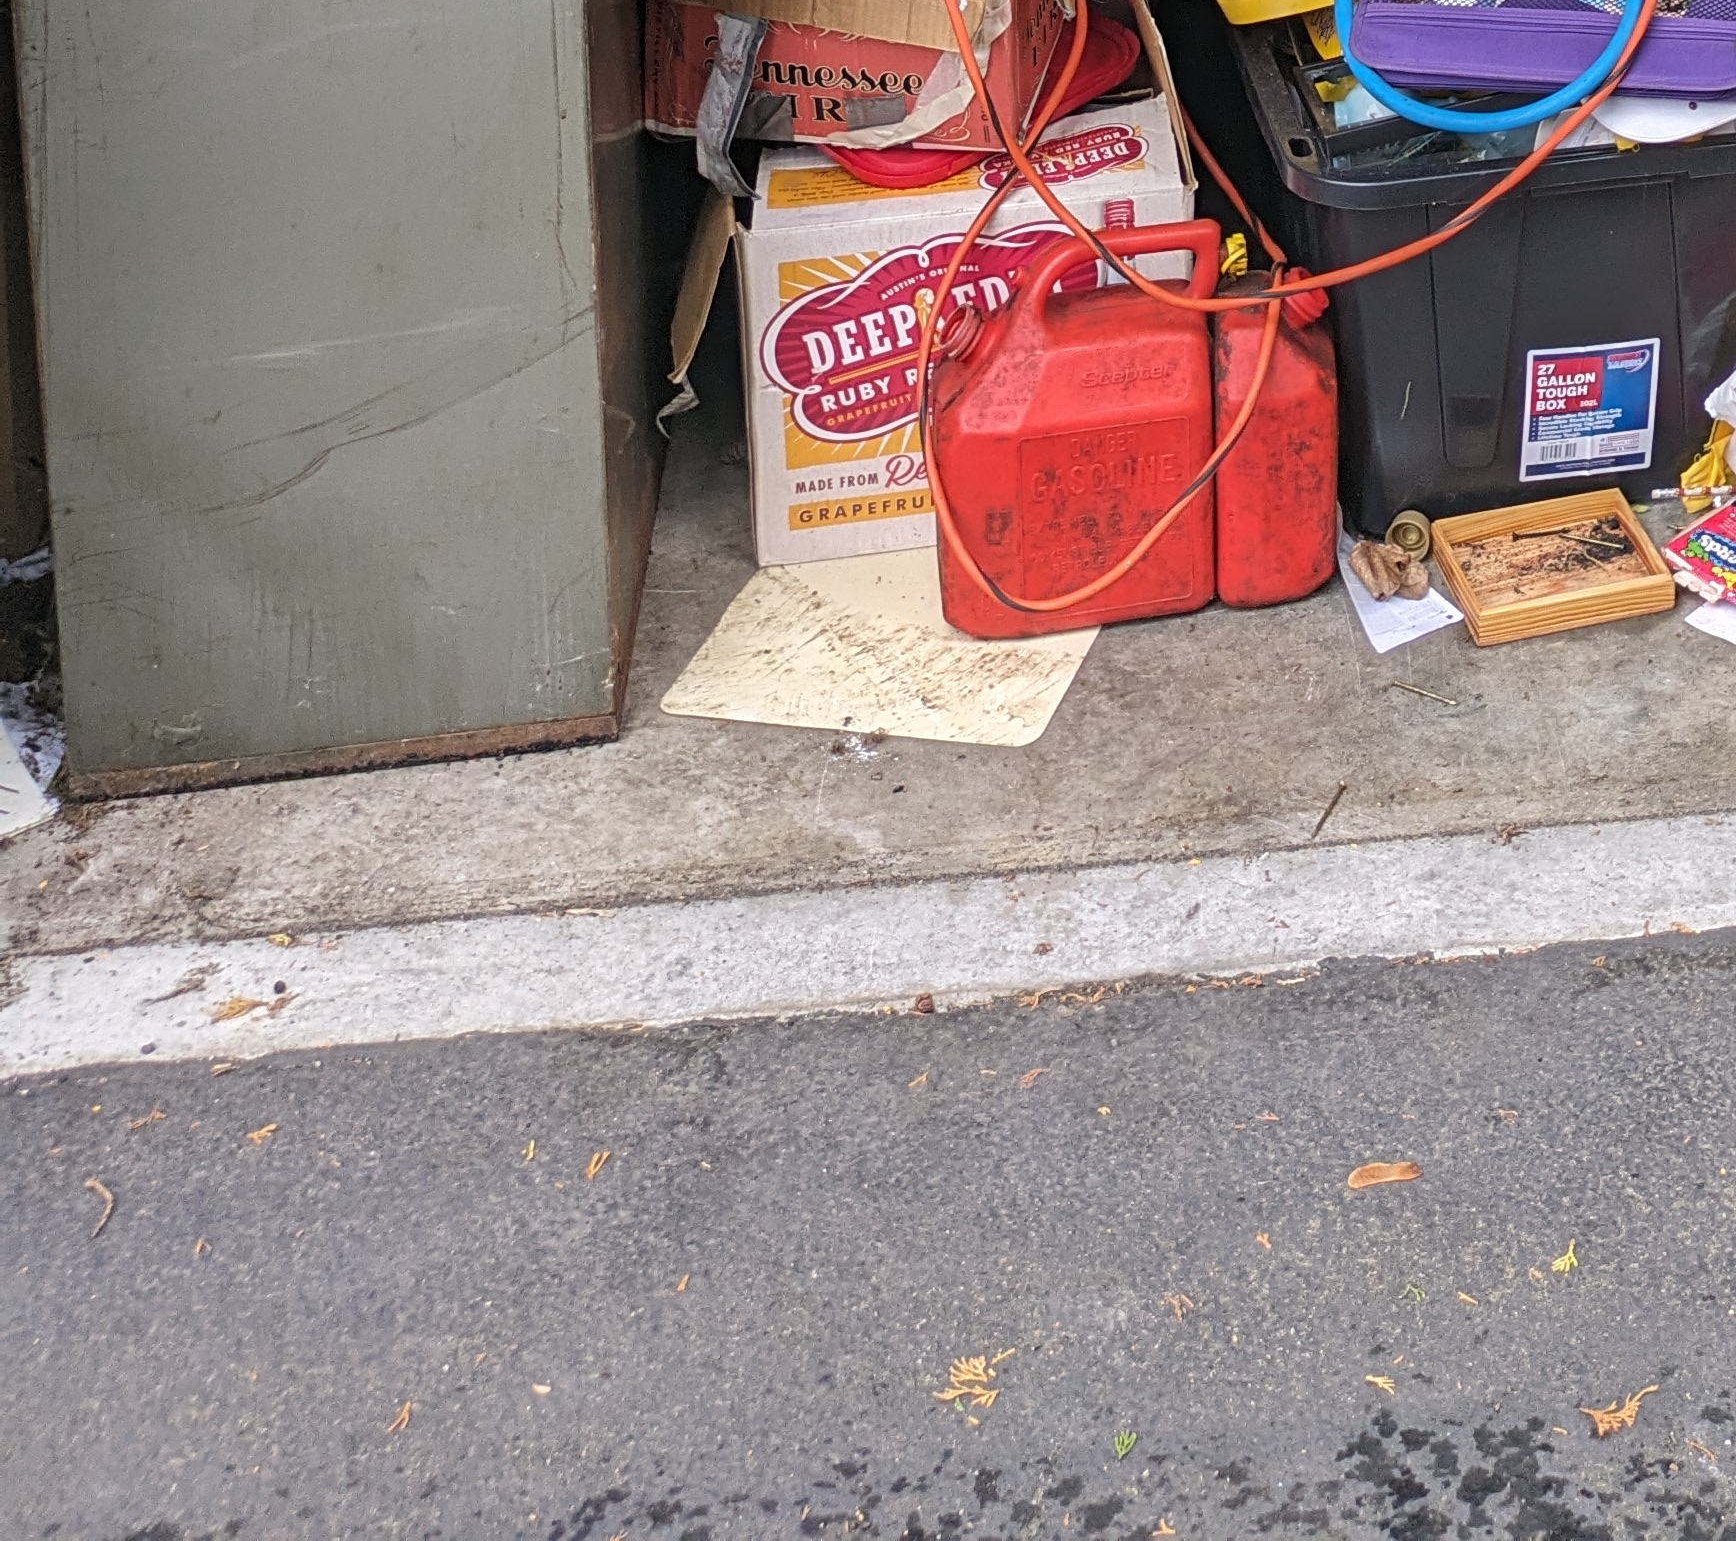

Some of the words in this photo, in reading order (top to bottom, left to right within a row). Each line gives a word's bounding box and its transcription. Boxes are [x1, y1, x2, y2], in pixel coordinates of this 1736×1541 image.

[1072, 141, 1131, 171] DEEP
[879, 270, 927, 301] AUSTIN'S
[802, 304, 918, 375] DEEP
[1080, 364, 1178, 389] Scepter
[1536, 372, 1597, 388] GALLON
[1537, 363, 1556, 376] 27
[820, 376, 892, 413] RUBY
[1535, 384, 1589, 400] TOUGH
[1535, 399, 1567, 412] BOX
[826, 393, 913, 427] GRAPEFRUIT
[1070, 430, 1136, 459] DANGER
[794, 475, 834, 495] MADE
[839, 472, 880, 490] FROM
[885, 454, 929, 489] Re
[1031, 452, 1178, 504] GASOLINE
[799, 495, 937, 524] GRAPEFRUI
